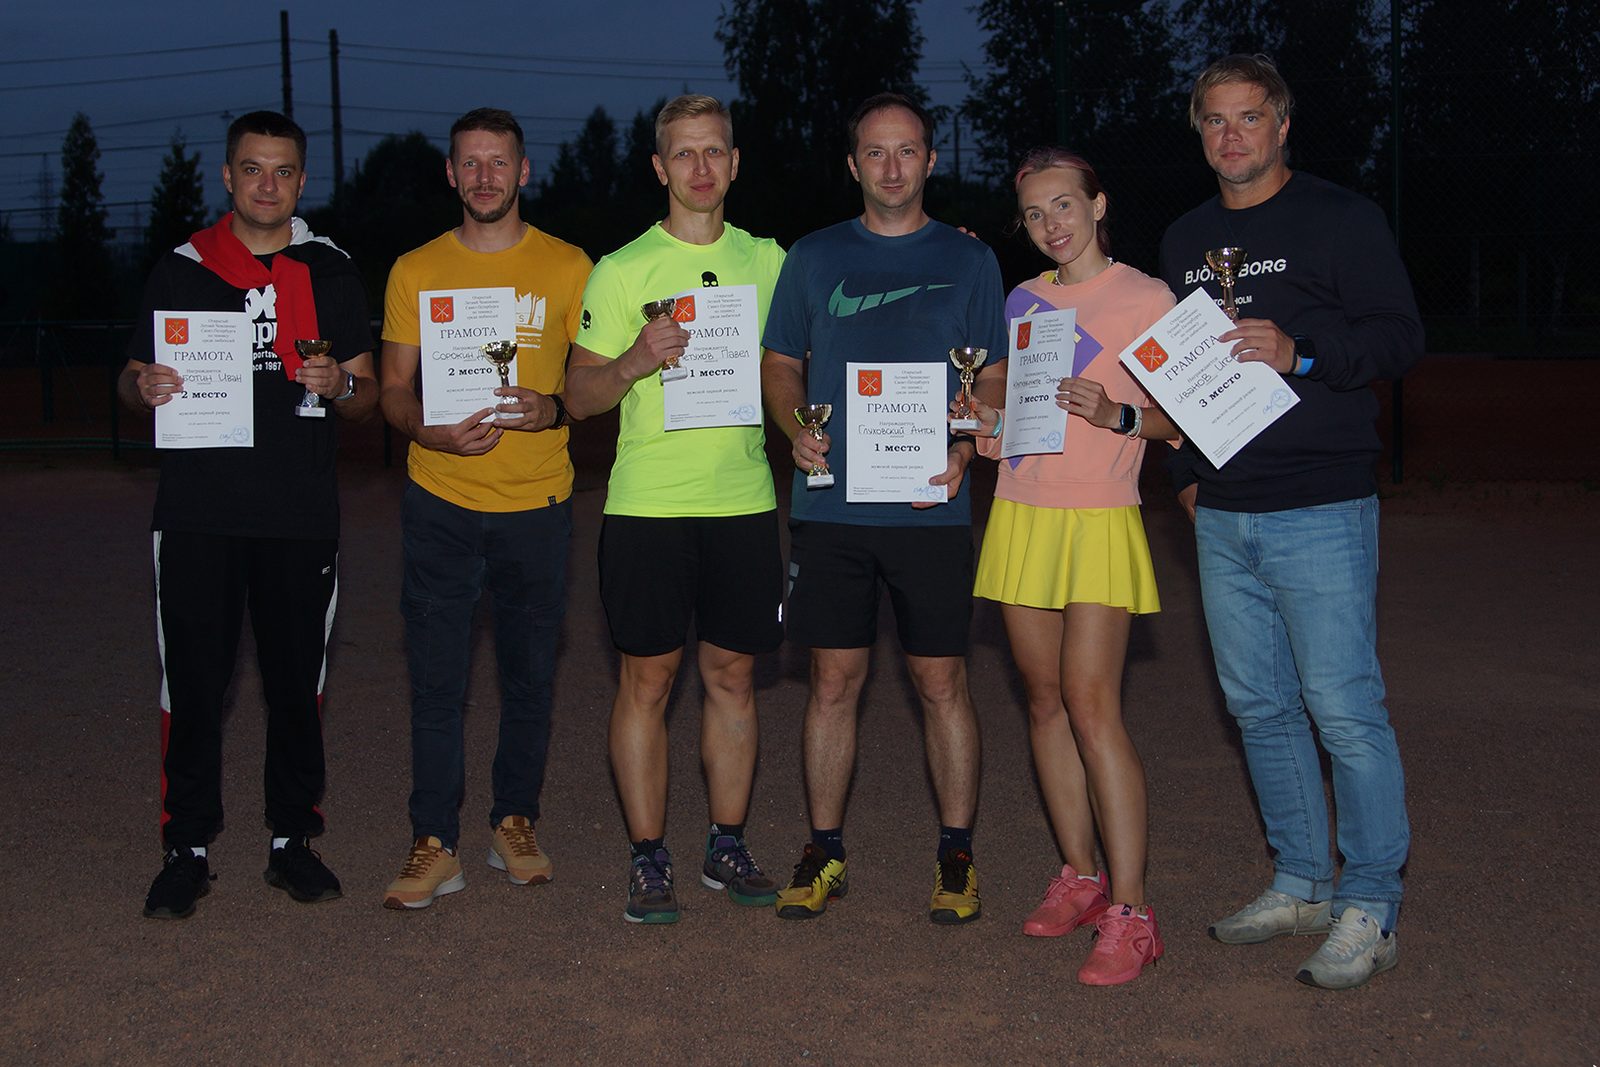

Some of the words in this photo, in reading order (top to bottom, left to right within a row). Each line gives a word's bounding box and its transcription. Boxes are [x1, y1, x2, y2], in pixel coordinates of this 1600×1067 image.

[1184, 265, 1221, 285] BJÖ
[1238, 259, 1287, 278] BORG
[440, 327, 498, 339] ГРАМОТА
[688, 326, 740, 338] РАМОТА
[174, 351, 234, 361] ГРАМОТА
[683, 352, 714, 361] етухов
[721, 349, 750, 358] Павел
[1020, 352, 1059, 366] ГРАМОТА
[1165, 335, 1220, 381] ГРАМОТА
[265, 361, 282, 370] 1967
[448, 368, 456, 376] 2
[458, 367, 493, 376] место
[690, 369, 695, 378] 1
[700, 368, 735, 377] место
[181, 391, 188, 399] 2
[192, 391, 228, 399] место
[1198, 398, 1208, 408] 3
[1208, 372, 1242, 400] место
[1024, 394, 1050, 404] место
[867, 403, 927, 413] ГРАМОТА
[910, 425, 936, 436] Антон
[874, 443, 880, 452] 1
[884, 444, 921, 452] место
